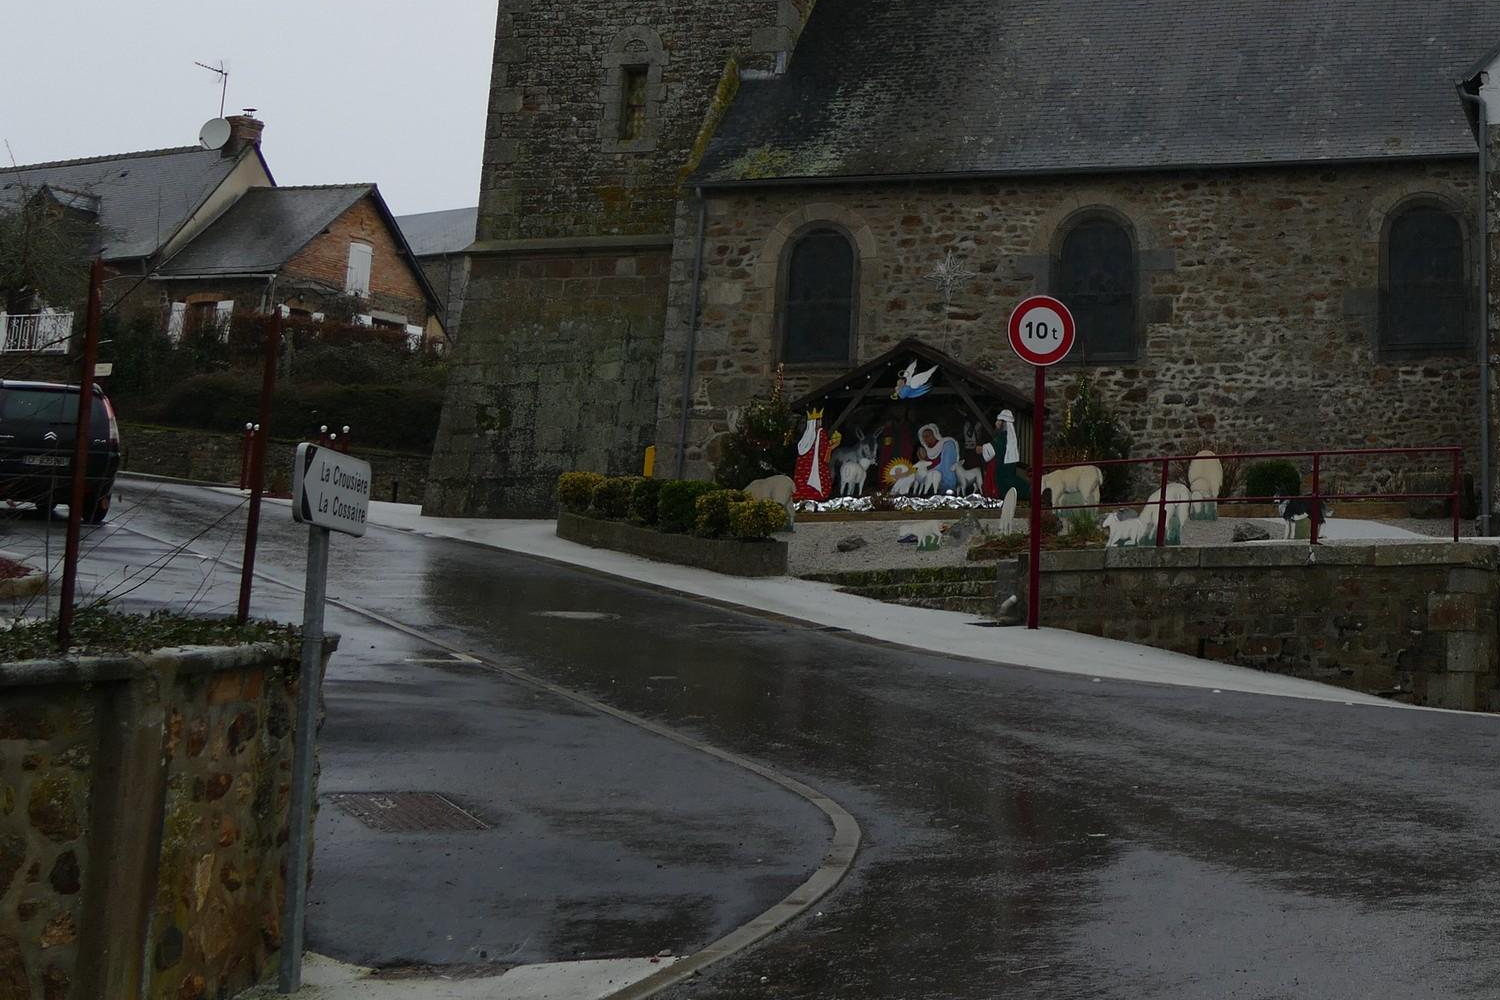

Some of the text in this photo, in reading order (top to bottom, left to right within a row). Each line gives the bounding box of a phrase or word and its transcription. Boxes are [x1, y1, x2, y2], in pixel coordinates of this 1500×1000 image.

[1025, 321, 1058, 340] 10 t
[320, 461, 368, 494] La Crousière
[318, 492, 366, 523] La Cossaire
